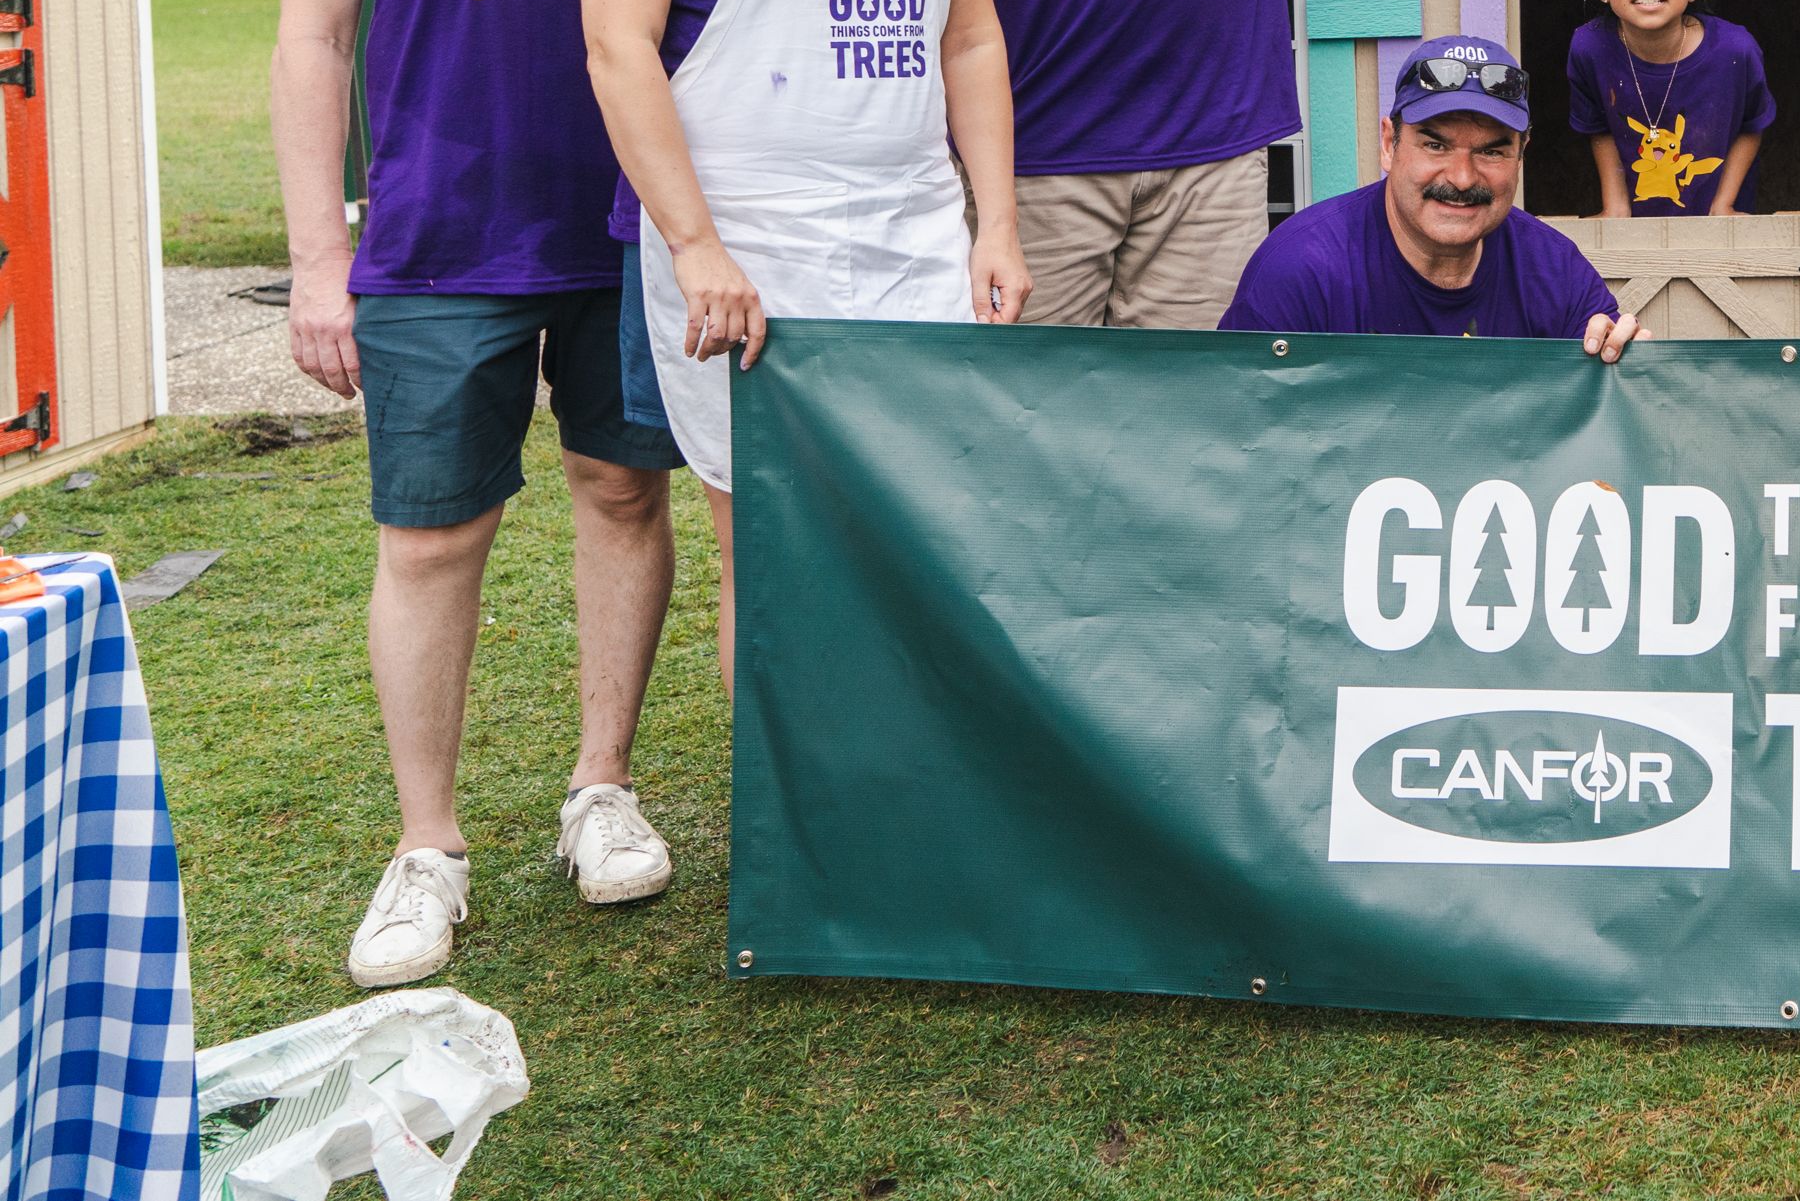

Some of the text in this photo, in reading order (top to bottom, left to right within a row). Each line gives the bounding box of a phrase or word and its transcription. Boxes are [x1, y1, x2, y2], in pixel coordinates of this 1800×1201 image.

[830, 25, 924, 37] THINGS COME FROM
[830, 40, 926, 79] TREES
[1444, 46, 1489, 60] GOOD
[1441, 65, 1488, 79] TRS
[1343, 477, 1736, 656] GOOD
[1391, 738, 1674, 813] CANFOR
